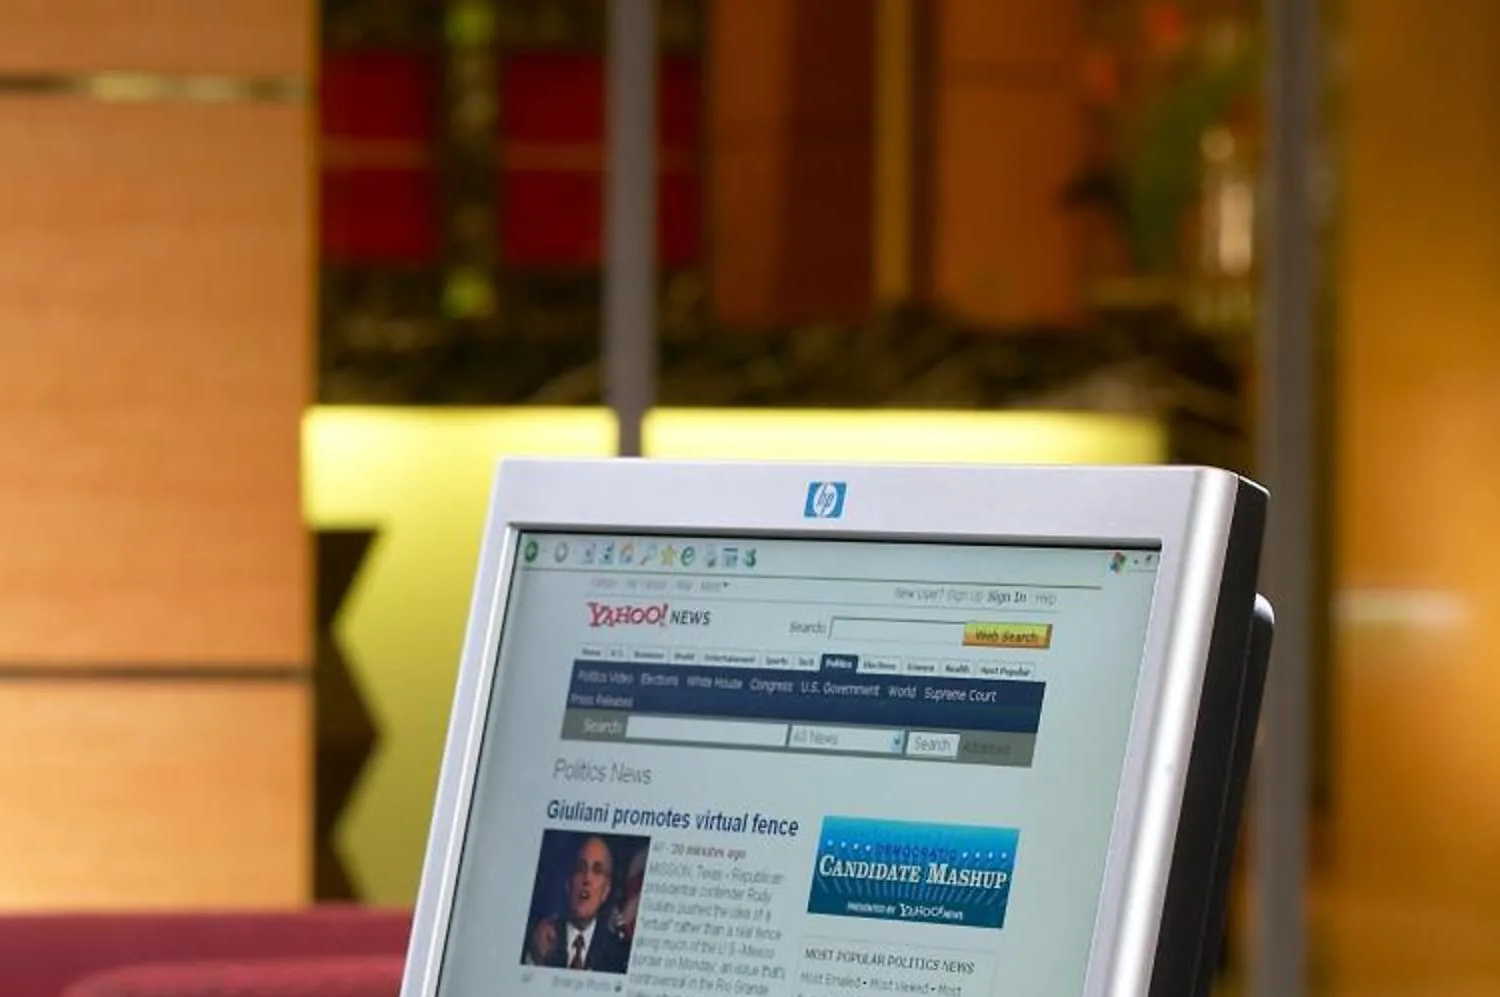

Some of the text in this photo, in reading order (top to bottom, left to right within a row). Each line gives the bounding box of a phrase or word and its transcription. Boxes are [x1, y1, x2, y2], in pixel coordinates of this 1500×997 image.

[987, 590, 1011, 605] Sign
[1013, 591, 1027, 603] In
[585, 601, 712, 628] YAHOO! NEWS
[974, 628, 1039, 643] Web Search
[641, 673, 679, 687] Elections
[714, 676, 744, 690] House
[749, 678, 796, 695] Congress
[800, 680, 881, 697] U.S. Government
[887, 684, 917, 698] World
[923, 686, 998, 704] Supreme Court
[583, 718, 623, 735] Search
[810, 730, 839, 746] News
[914, 735, 952, 753] Search
[553, 757, 653, 785] Politics News
[547, 799, 800, 837] Giuliani promotes virtual fence
[685, 844, 726, 858] minutes
[727, 848, 747, 861] ago
[819, 854, 1008, 889] CANDIDATE MASHUP
[703, 922, 726, 936] than
[754, 926, 783, 940] fence
[804, 947, 975, 976] MOST POPULAR POLITICS NEWS
[715, 977, 732, 992] Rio
[800, 970, 823, 985] Most
[868, 977, 894, 992] Most
